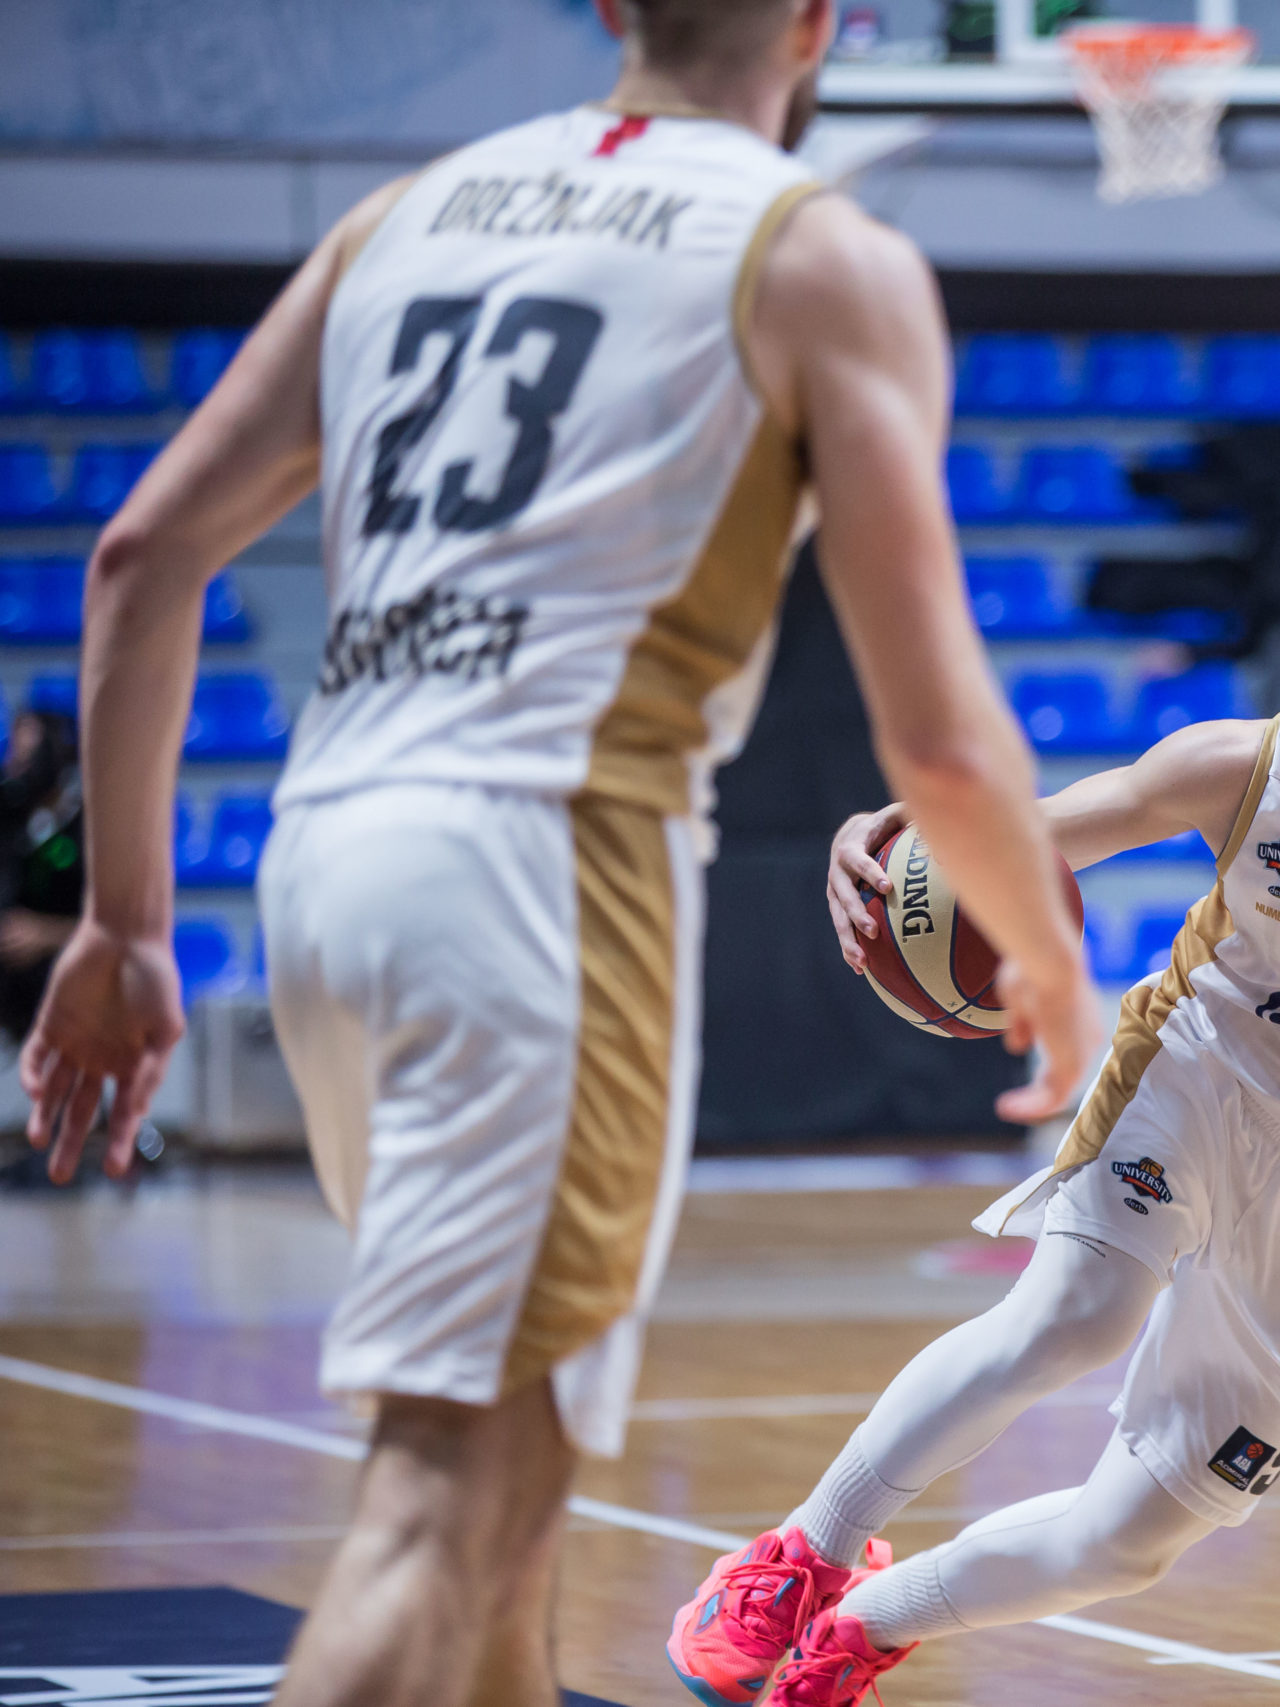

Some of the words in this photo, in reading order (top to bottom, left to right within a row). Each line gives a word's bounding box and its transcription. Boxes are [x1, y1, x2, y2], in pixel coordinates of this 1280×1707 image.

[427, 168, 697, 252] DREŽNJAK
[362, 296, 606, 538] 23
[1114, 1162, 1171, 1202] UNIVERSITY
[1125, 1198, 1147, 1214] derby
